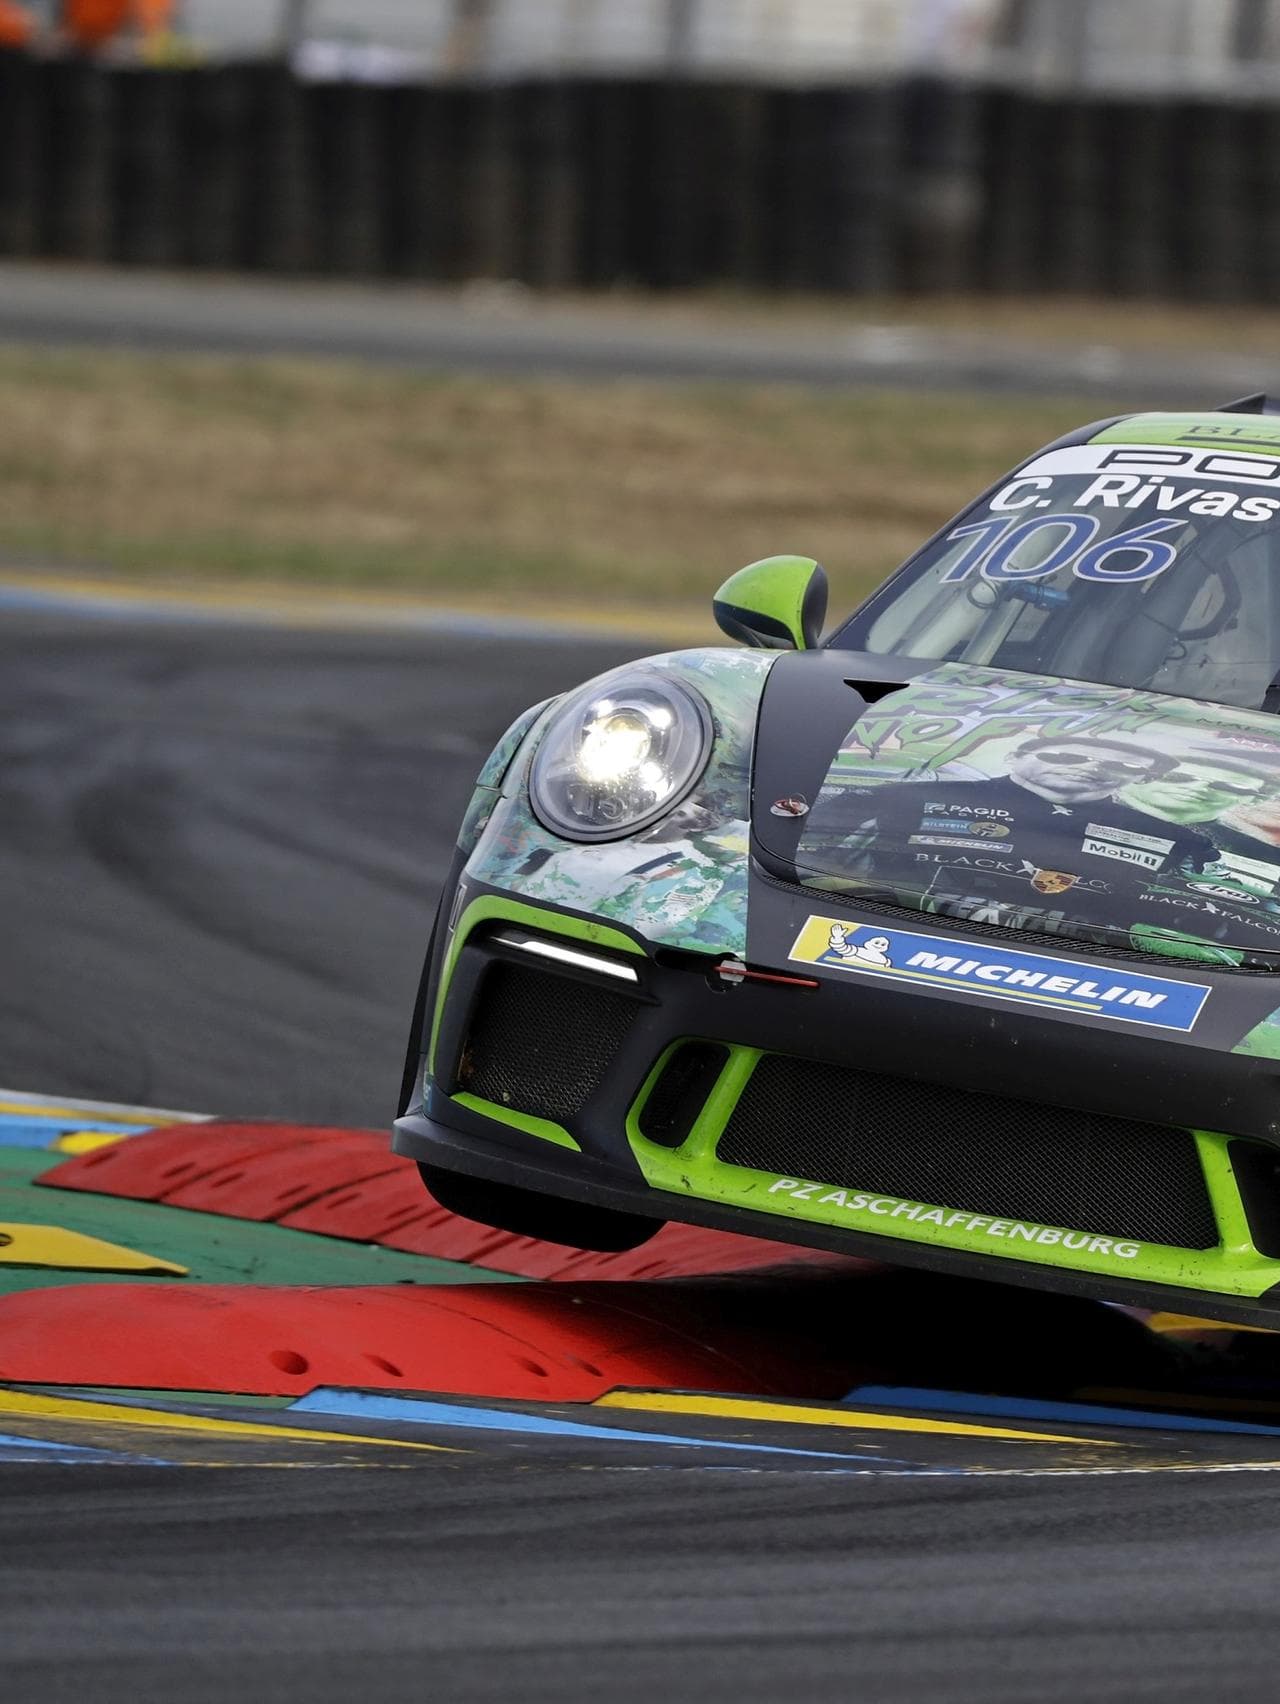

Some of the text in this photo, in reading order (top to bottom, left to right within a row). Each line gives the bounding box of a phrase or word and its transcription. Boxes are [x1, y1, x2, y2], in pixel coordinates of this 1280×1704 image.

[989, 475, 1280, 522] C. Rivas
[938, 513, 1189, 584] 106
[924, 809, 1015, 822] RACING
[949, 804, 1010, 817] PAGID
[914, 853, 1016, 871] BLACK
[1089, 843, 1142, 862] Mobil
[1138, 894, 1200, 911] BLACK
[905, 950, 1168, 1010] MICHELIN
[768, 1178, 1141, 1259] PZ ASCHAFFENBURG
